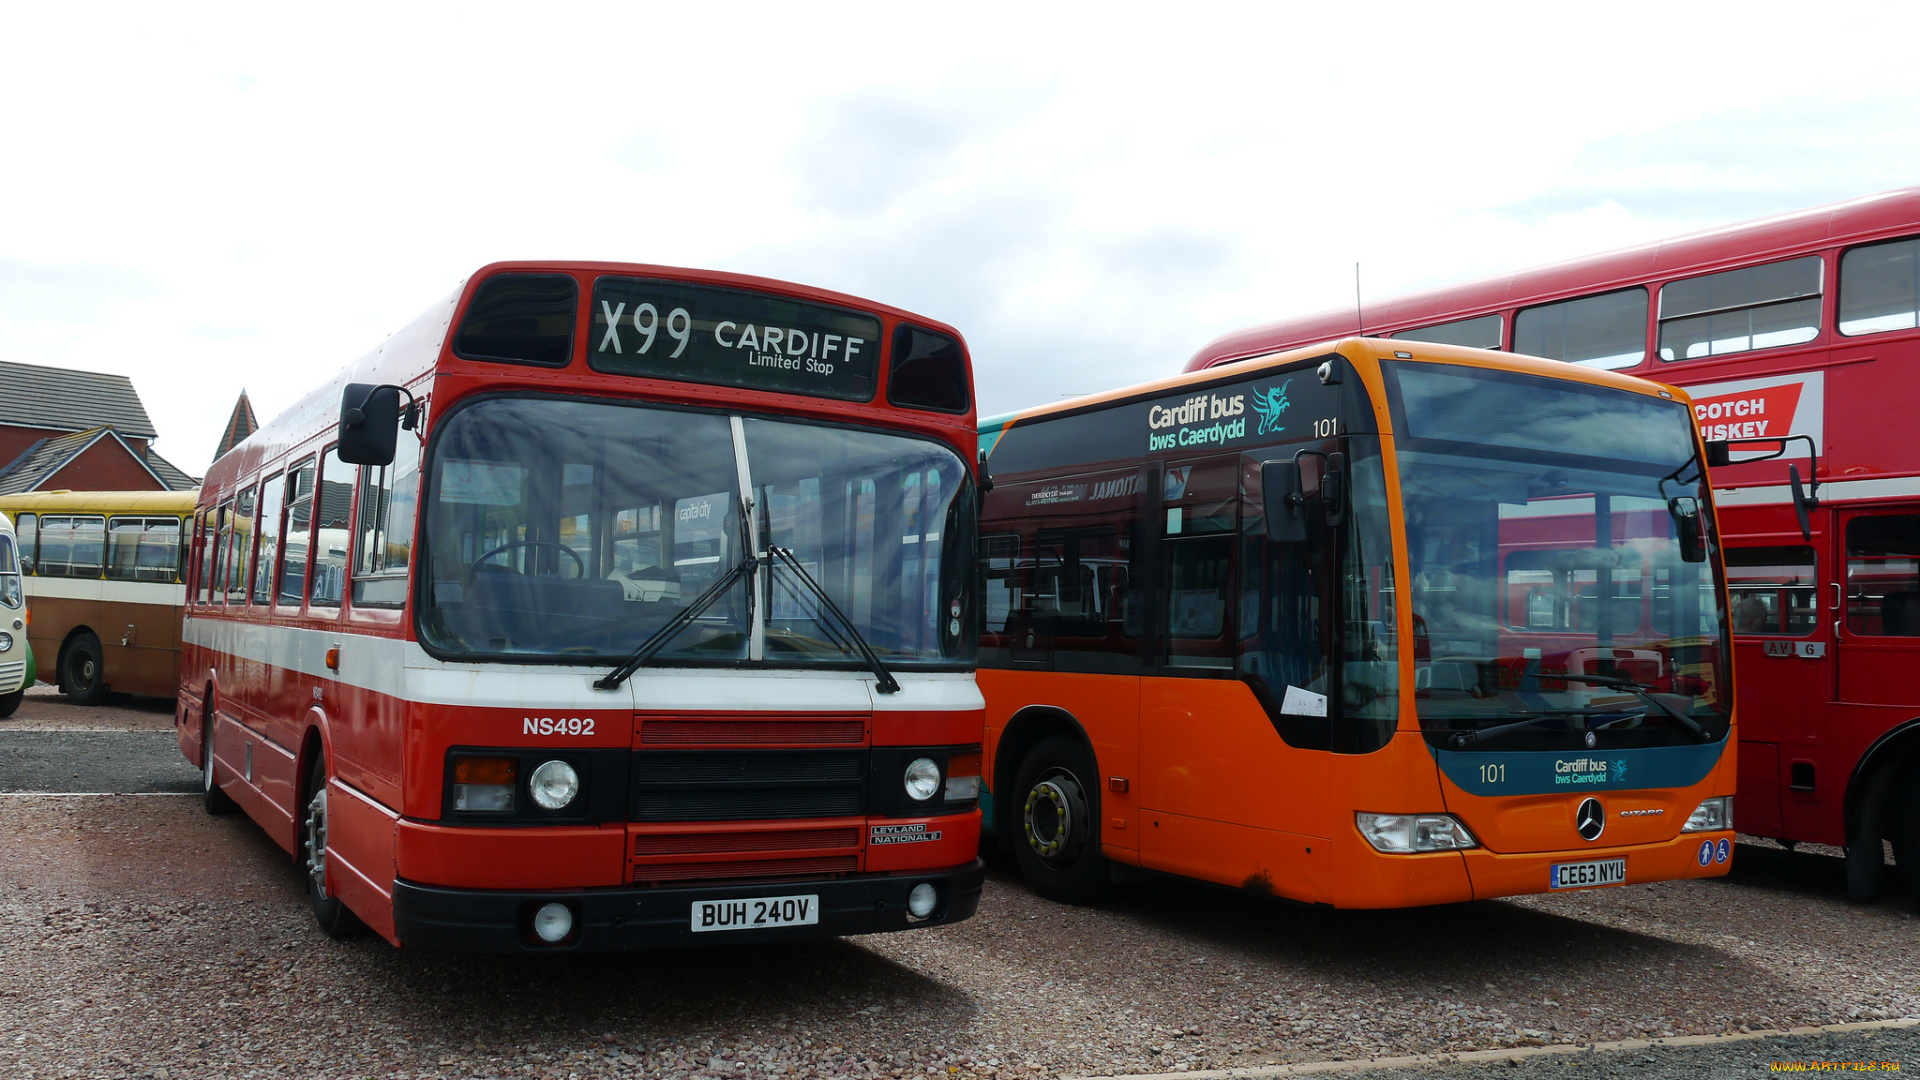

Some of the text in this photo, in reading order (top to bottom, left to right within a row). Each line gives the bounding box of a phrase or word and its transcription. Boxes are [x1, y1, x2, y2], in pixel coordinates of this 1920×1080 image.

[598, 300, 865, 362] X99 CARDIFF
[749, 351, 834, 376] Limited Stop
[1148, 394, 1245, 430] Cardiff bus
[1694, 398, 1765, 421] COTCH
[1149, 417, 1246, 451] bws Caerdydd
[1313, 417, 1338, 439] 101
[1701, 420, 1769, 440] ISKEY
[680, 502, 699, 523] capital
[699, 501, 712, 519] city
[1768, 642, 1814, 655] AV 6
[523, 717, 595, 735] NS492
[1480, 764, 1505, 783] 101
[1555, 758, 1607, 773] Cardiff bus
[1555, 772, 1607, 784] bws Caerdydd
[1620, 808, 1664, 817] CITARO
[874, 826, 924, 834] LEYLAND
[875, 833, 929, 844] NATIONAL
[1560, 862, 1624, 885] CE63 NYU
[702, 899, 810, 927] BUH 240V
